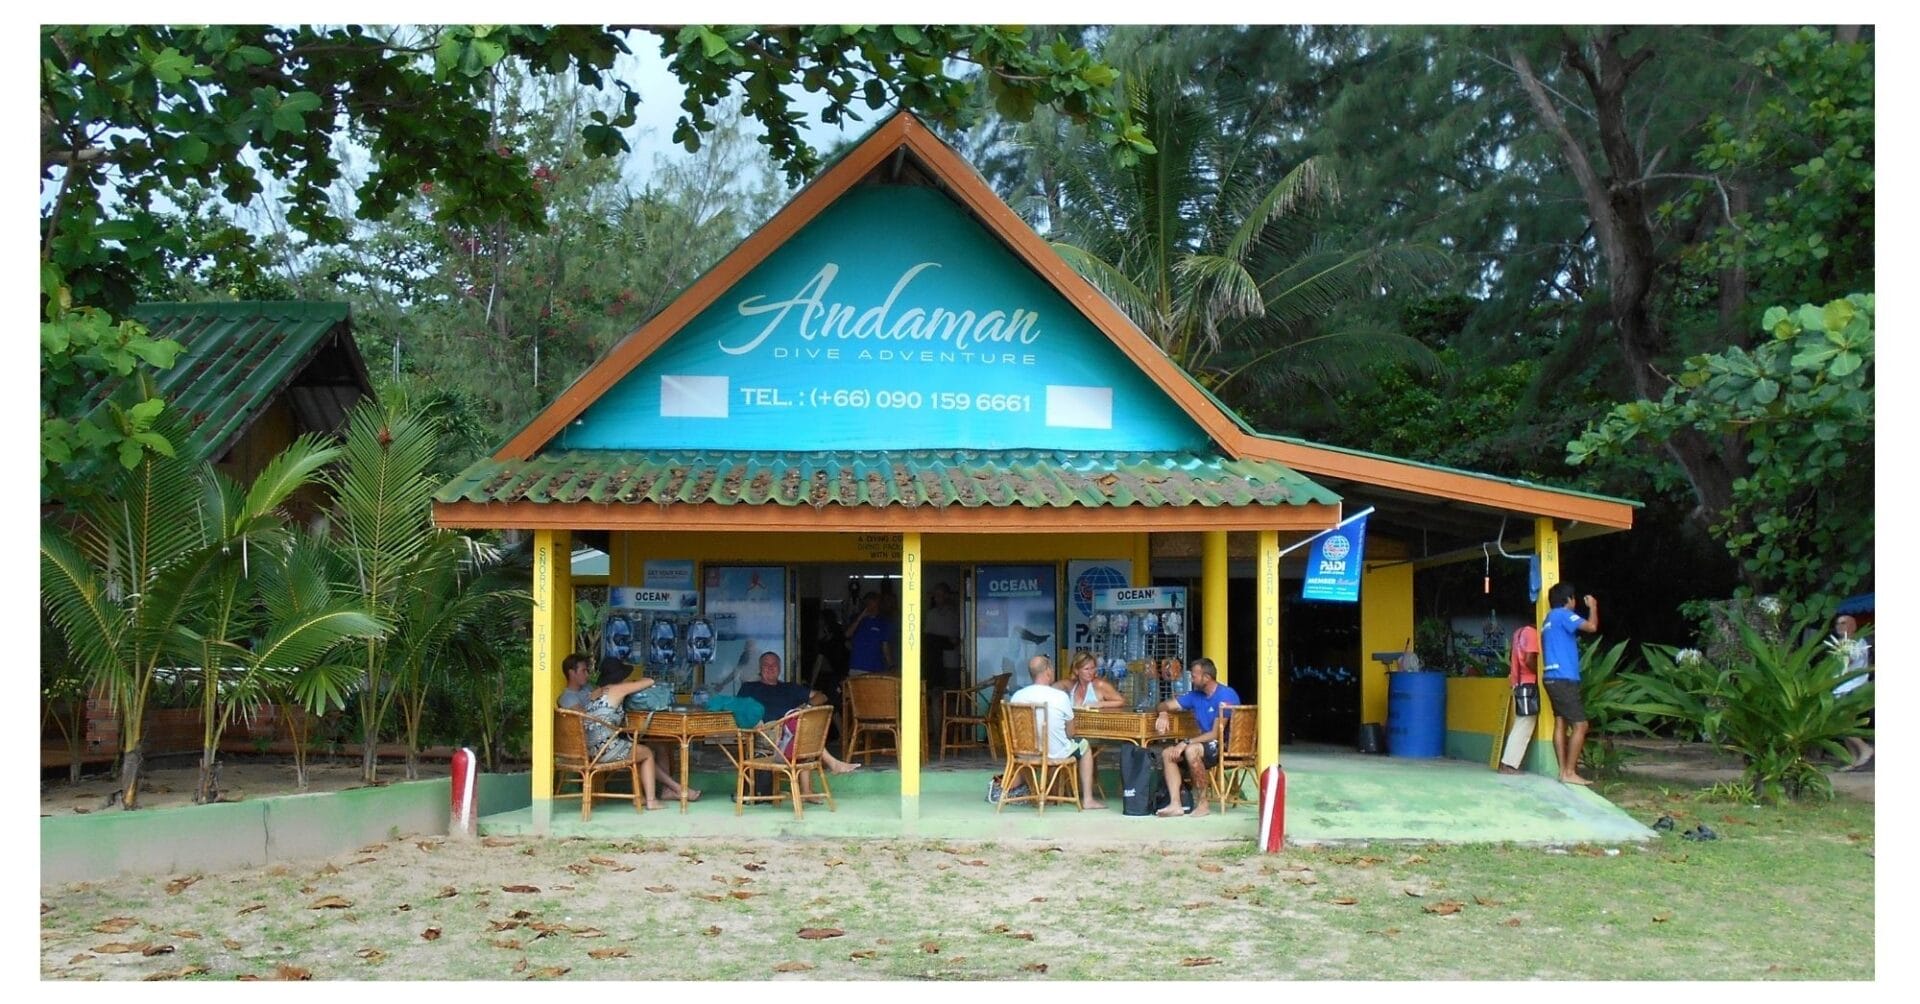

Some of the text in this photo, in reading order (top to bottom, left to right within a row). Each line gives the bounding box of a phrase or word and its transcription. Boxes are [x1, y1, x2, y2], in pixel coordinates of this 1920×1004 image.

[718, 262, 1041, 355] Andaman
[774, 347, 1037, 365] DIVE ADVENTURE
[740, 388, 793, 406] TEL.
[810, 387, 871, 408] (+66)
[876, 390, 922, 409] 090
[931, 392, 971, 411] 159
[976, 393, 1031, 412] 6661
[1319, 561, 1346, 572] PADI
[988, 578, 1039, 592] OCEAN
[635, 591, 668, 601] OCEAN
[1117, 589, 1152, 601] OCEAN
[1266, 607, 1273, 626] TO
[908, 603, 916, 651] TODAY
[538, 624, 546, 671] TRIPS
